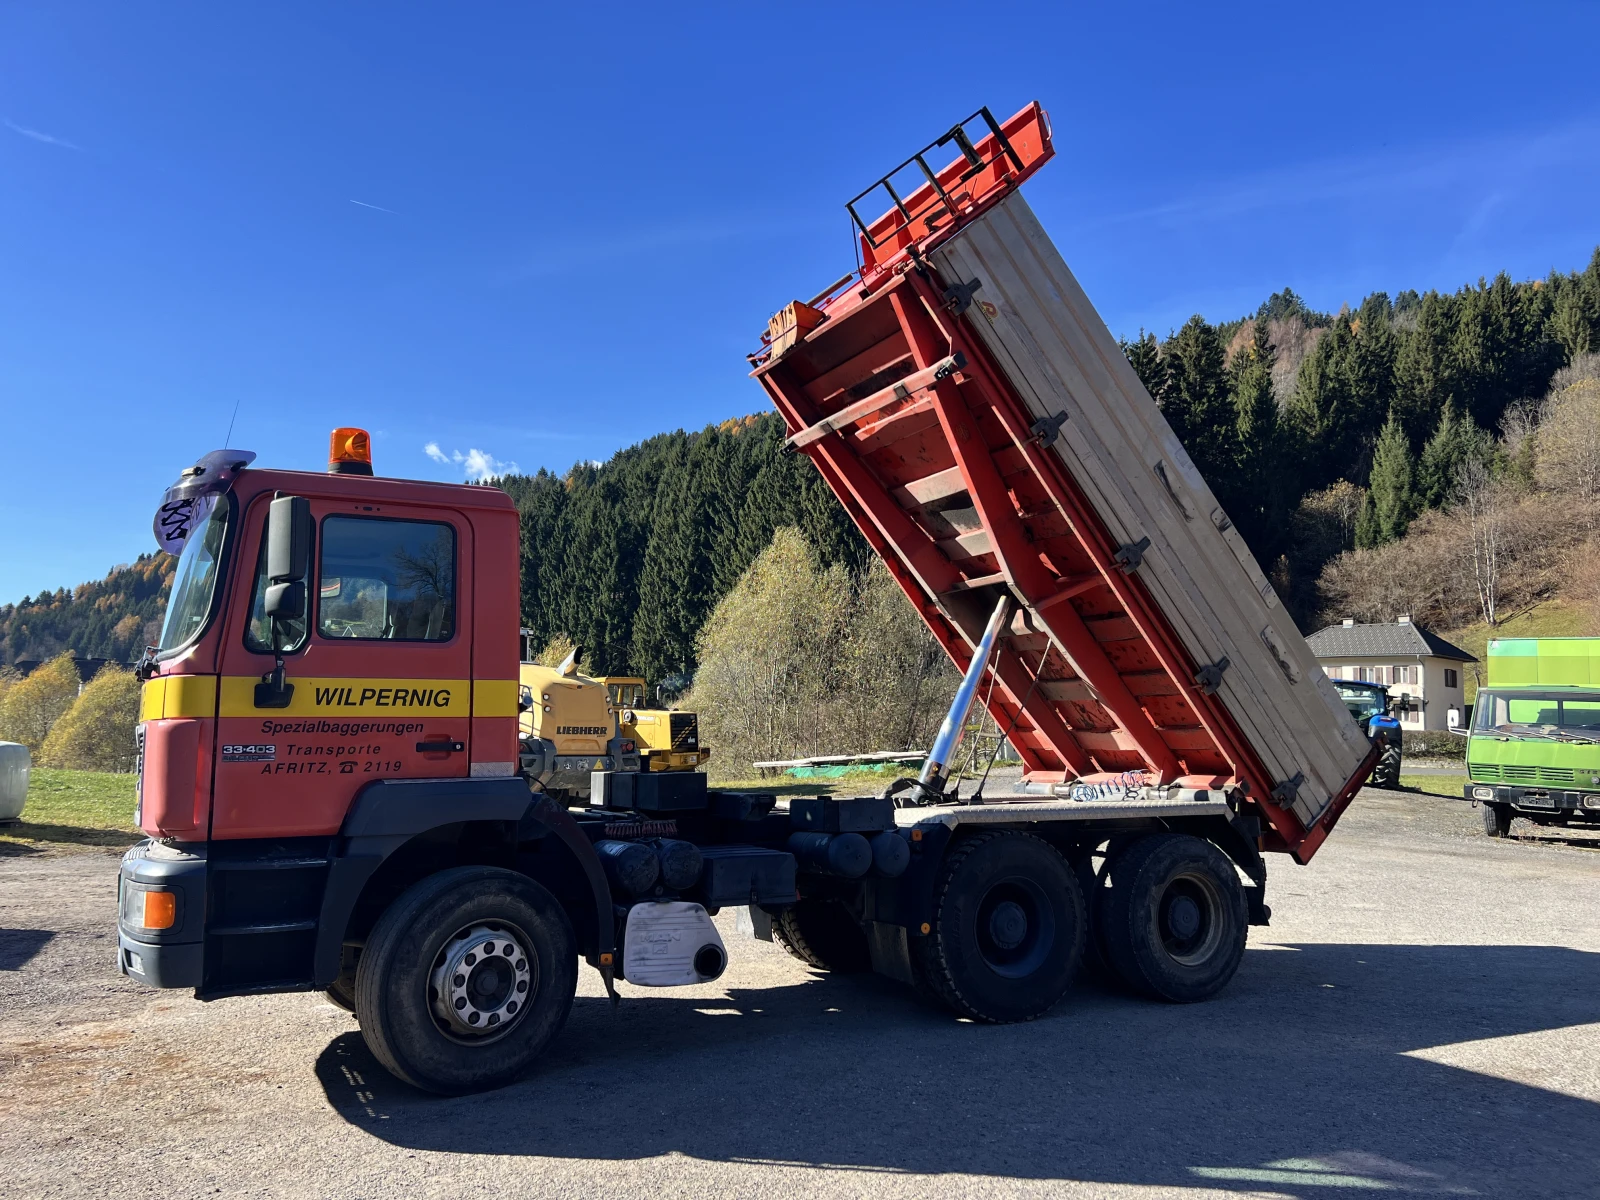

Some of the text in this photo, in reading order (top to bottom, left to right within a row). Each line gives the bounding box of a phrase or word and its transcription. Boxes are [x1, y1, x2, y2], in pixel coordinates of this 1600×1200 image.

[315, 687, 451, 707] WILPERNIG
[261, 721, 424, 736] Spezialbaggerungen
[556, 726, 607, 735] LIEBHERR
[286, 744, 381, 758] Transporte
[261, 761, 402, 775] AFRITZ, 2119
